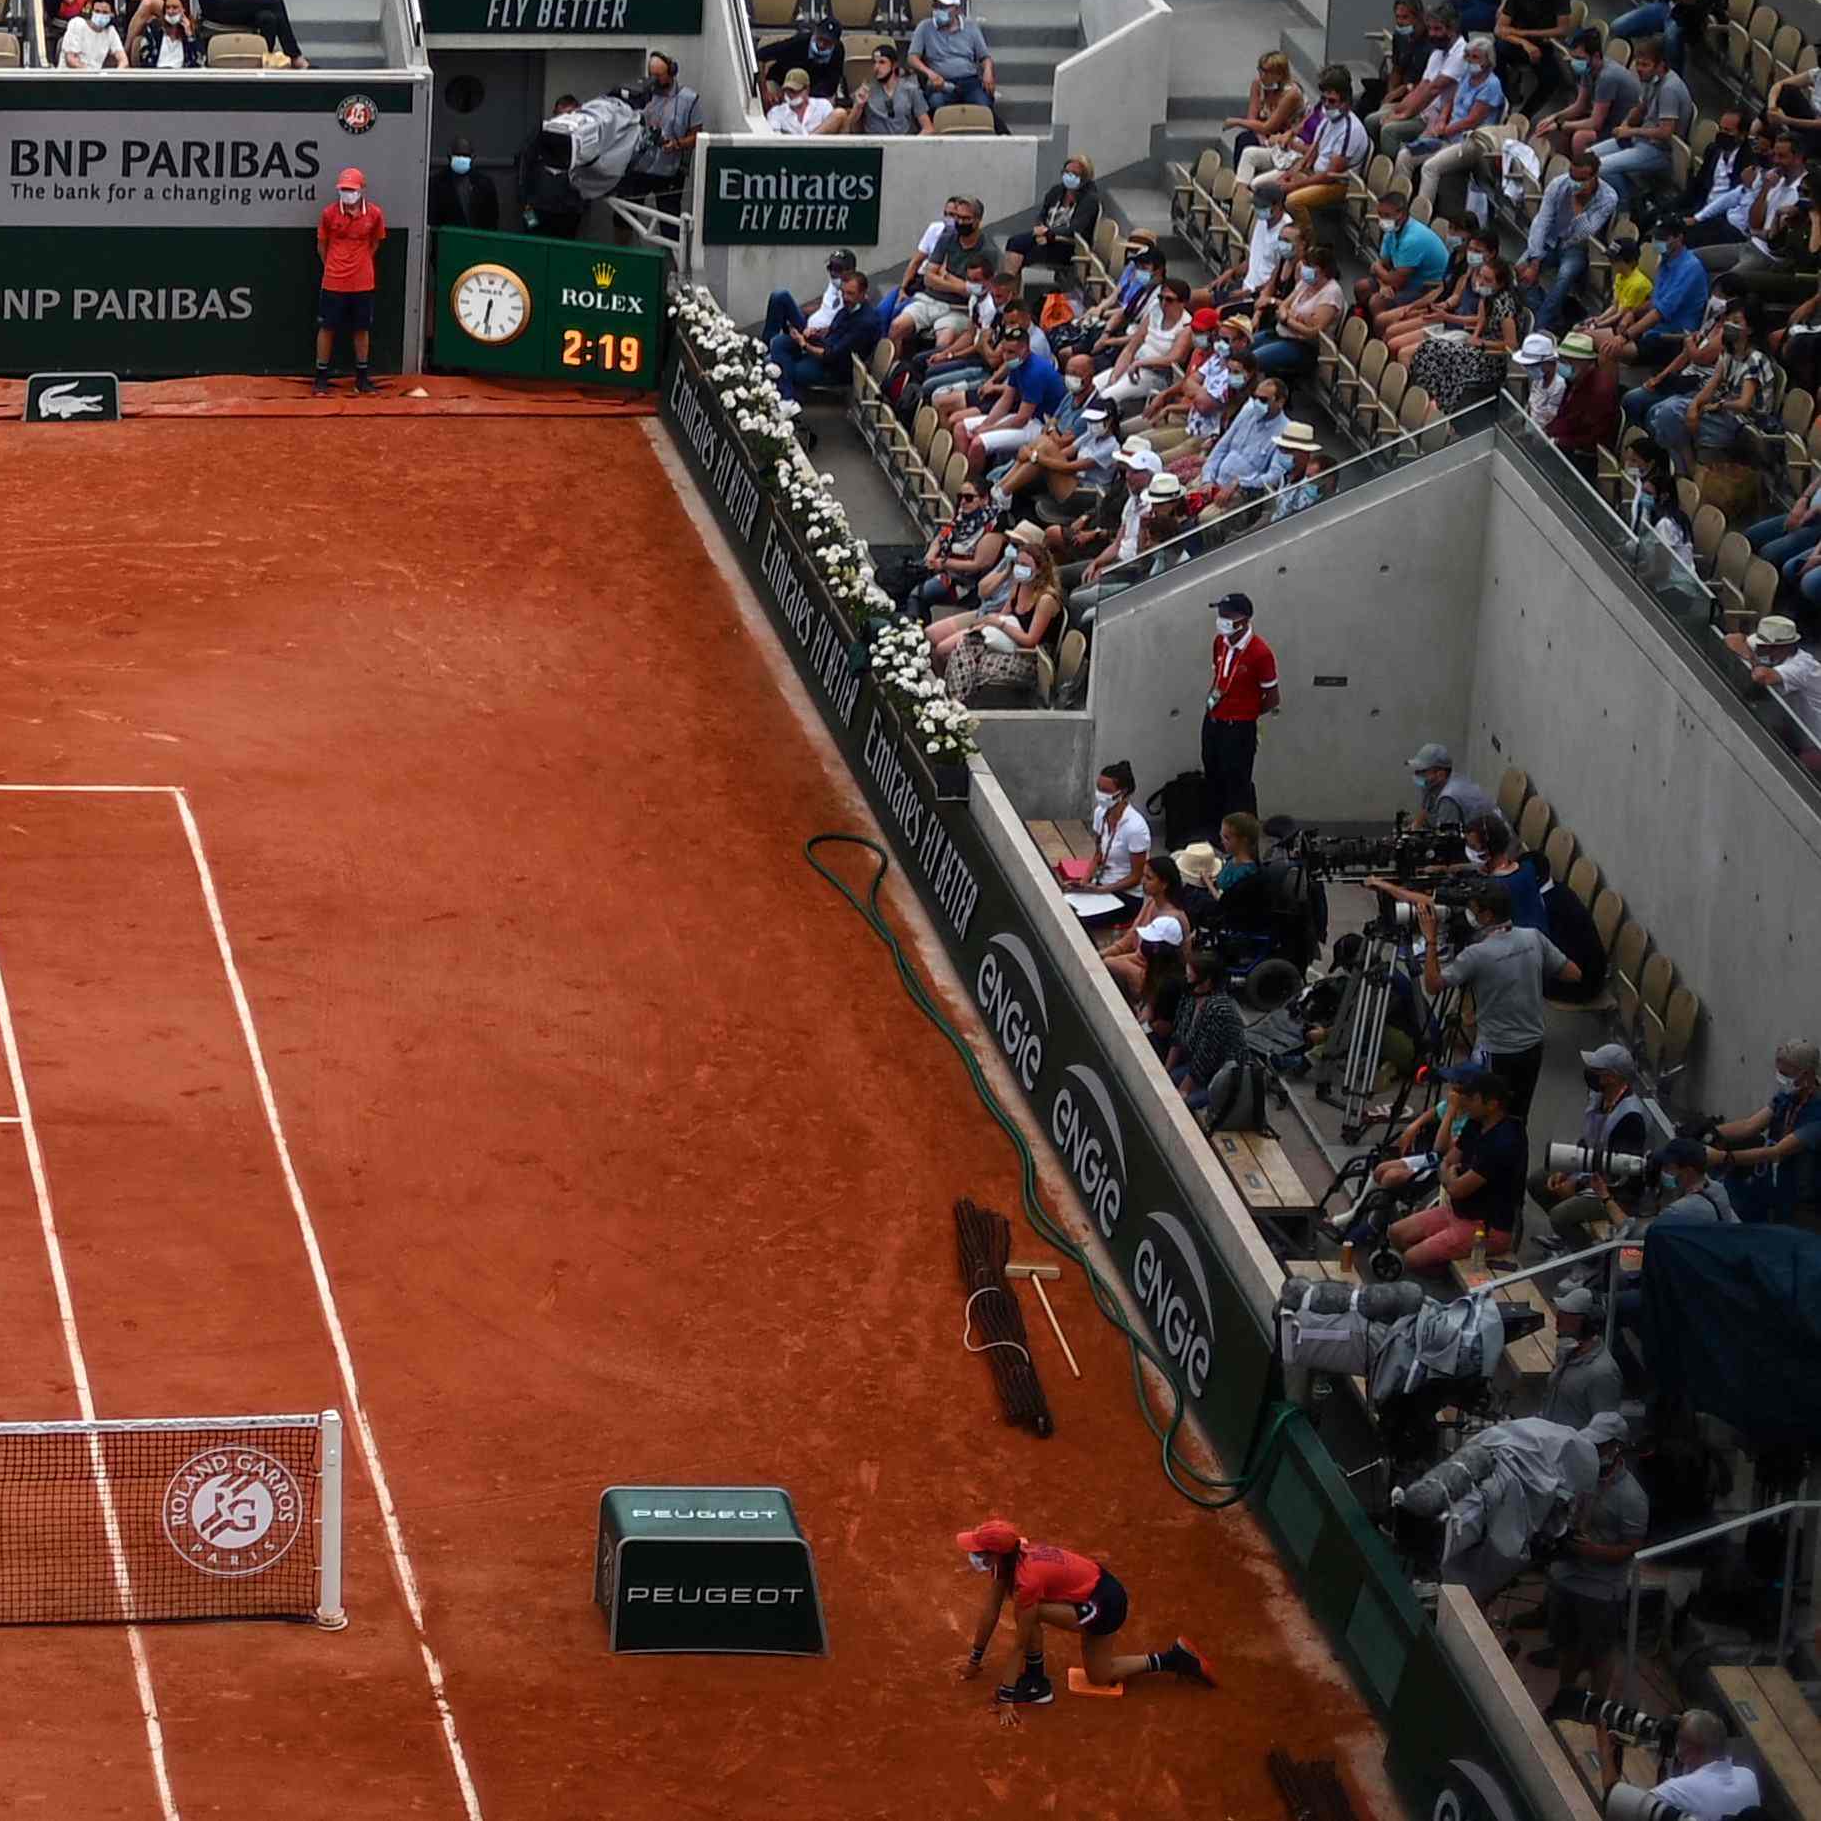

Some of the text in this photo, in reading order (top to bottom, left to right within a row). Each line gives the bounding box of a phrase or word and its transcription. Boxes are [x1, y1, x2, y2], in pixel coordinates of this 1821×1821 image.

[10, 139, 320, 179] BNP PARIBAS
[11, 183, 317, 205] The bank for a changing world
[719, 167, 874, 202] Emirates
[739, 204, 850, 231] FLY BETTER
[73, 287, 253, 321] PARIBAS
[561, 288, 644, 314] ROLEX
[562, 329, 640, 372] 2:19
[671, 359, 718, 470] Emirates
[760, 518, 814, 647] Emirates
[863, 706, 979, 943] Emirates FLY BETTER
[171, 1455, 294, 1526] ROLAND GARROS
[631, 1509, 778, 1520] PEUGEOT
[190, 1540, 275, 1566] PARIS
[627, 1587, 804, 1604] PEUGEOT
